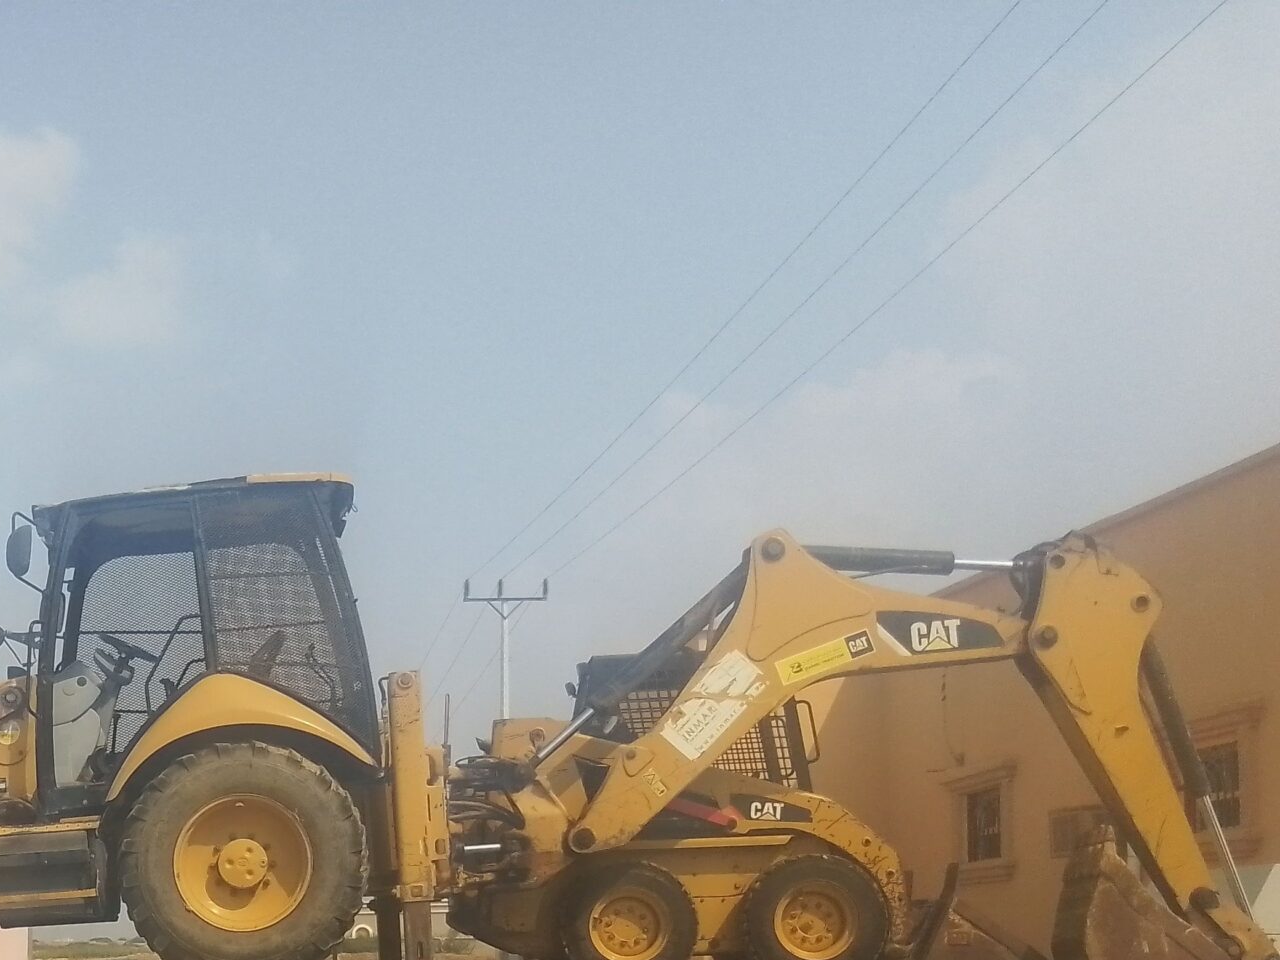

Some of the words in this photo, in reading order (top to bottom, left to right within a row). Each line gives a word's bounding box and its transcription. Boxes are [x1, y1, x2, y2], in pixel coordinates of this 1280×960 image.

[848, 636, 868, 653] CAT
[910, 619, 960, 651] CAT
[750, 801, 785, 820] CAT
